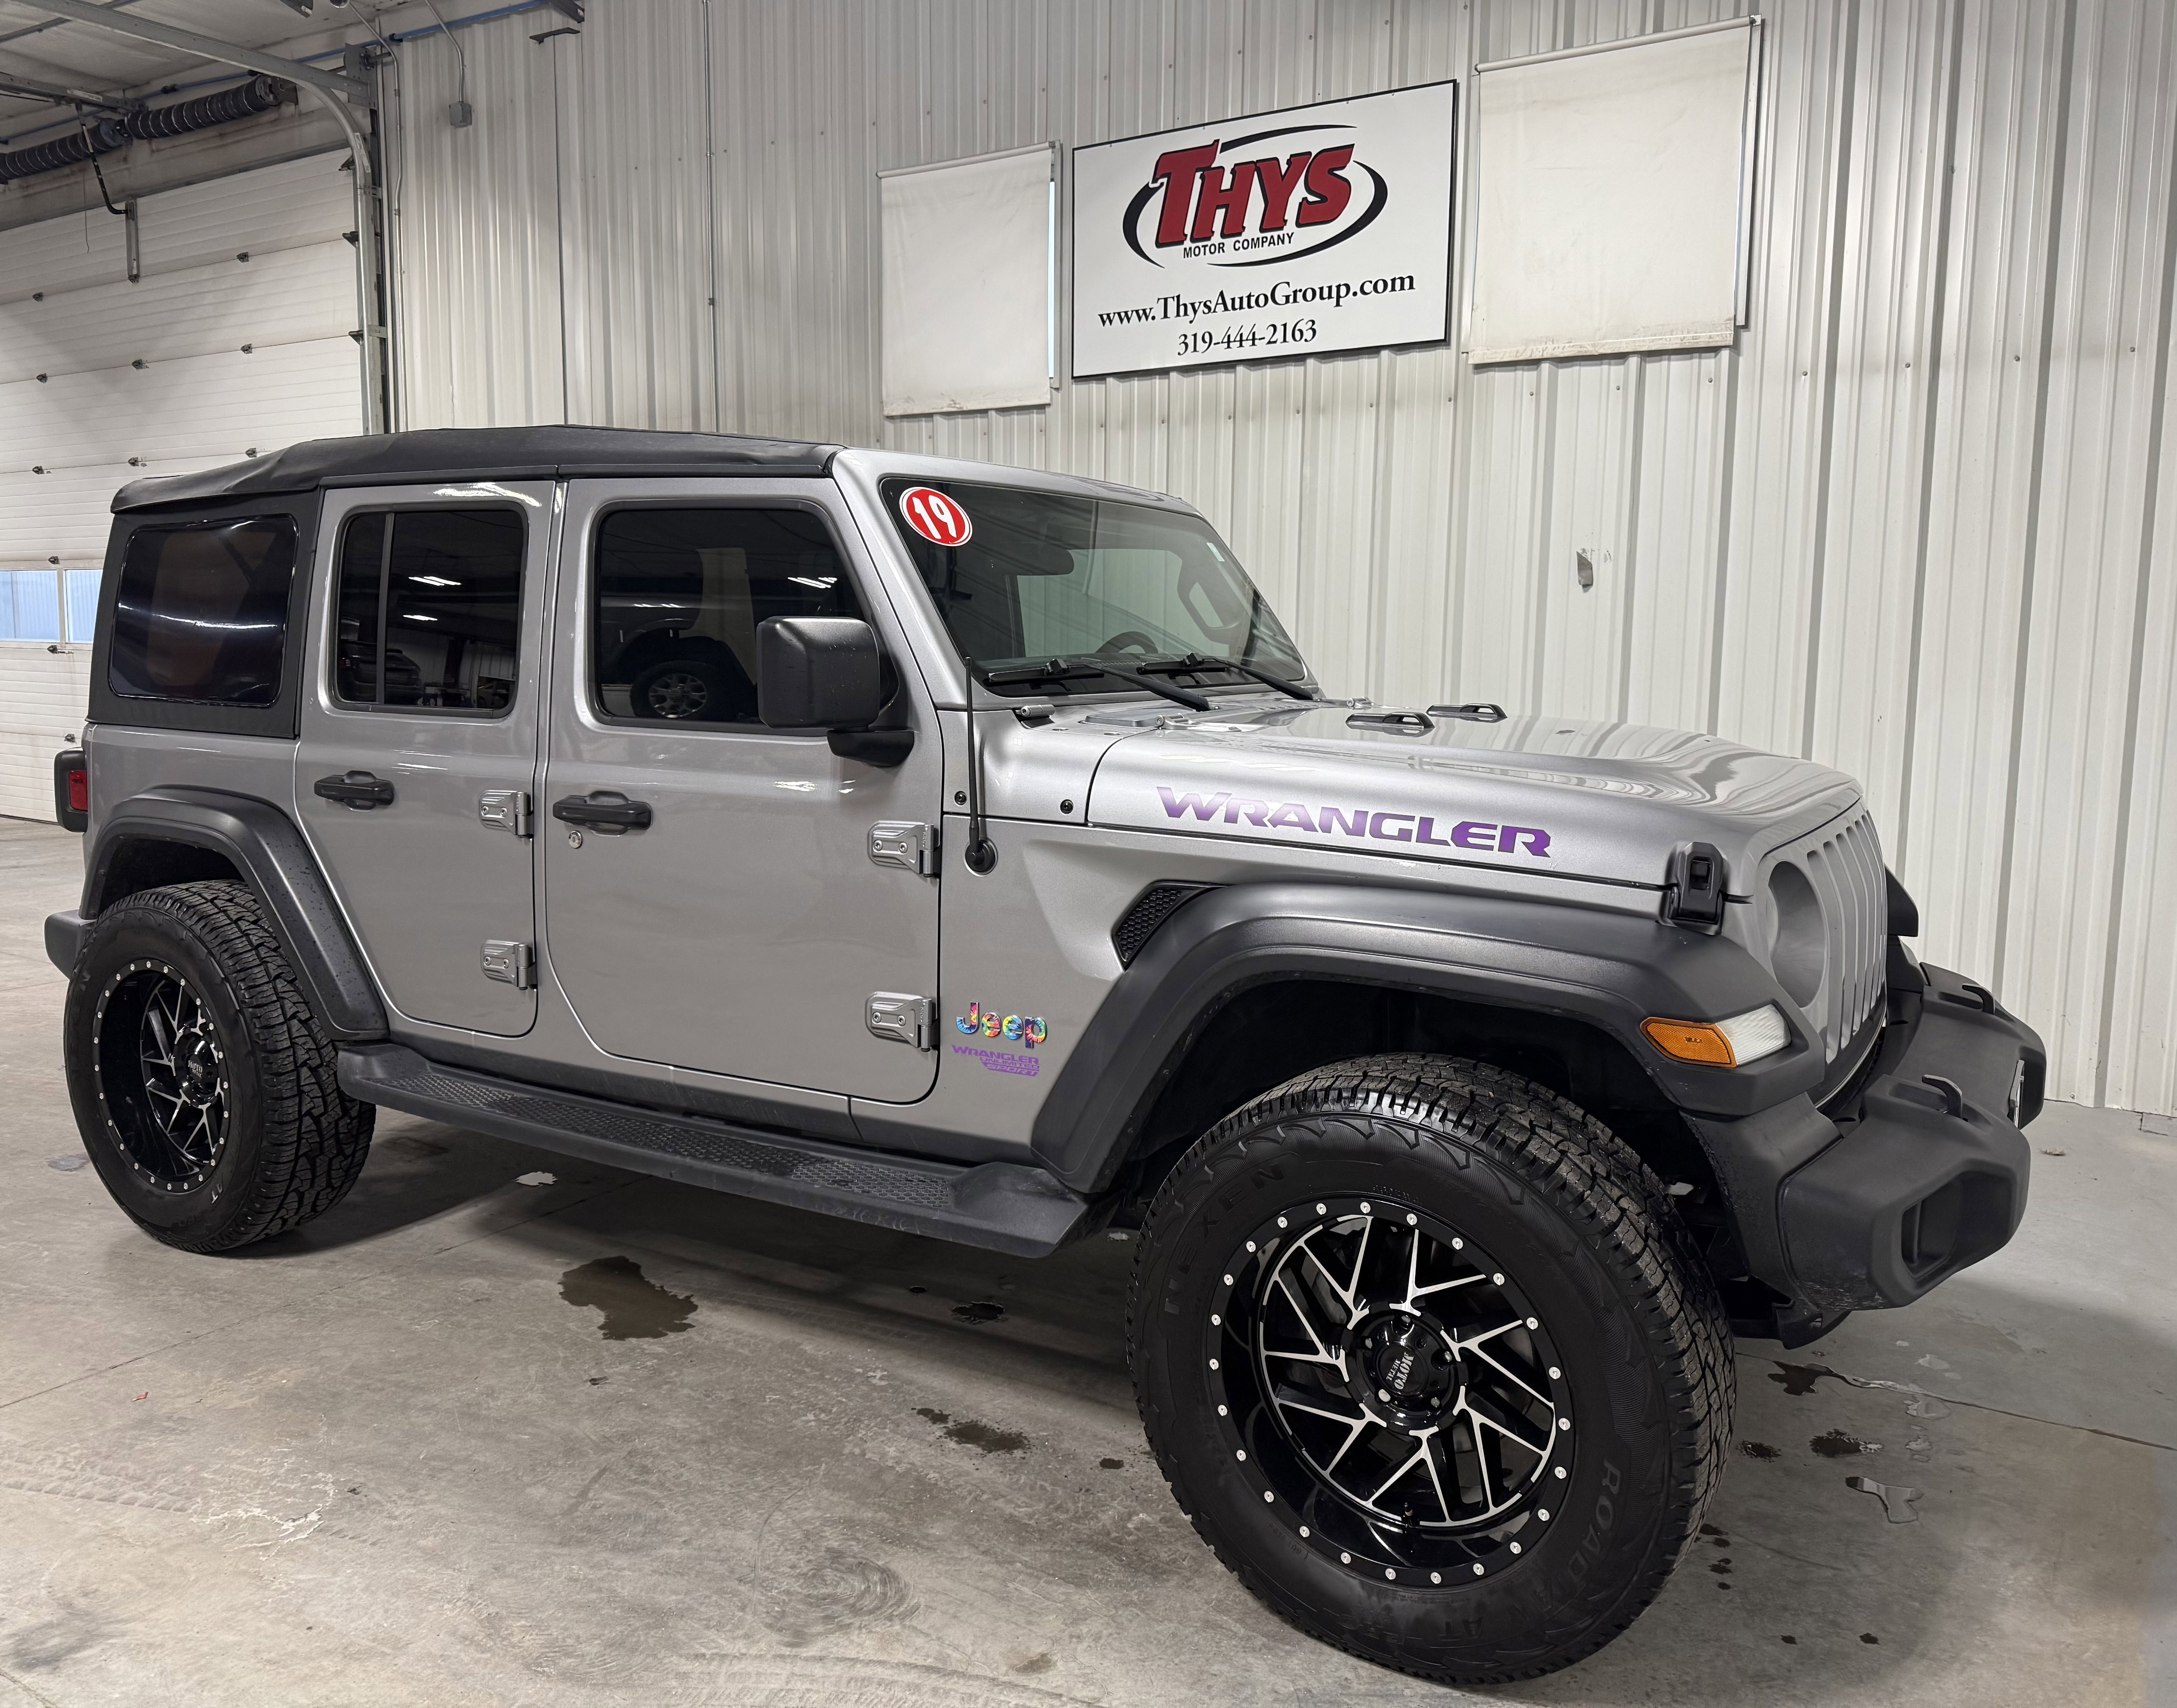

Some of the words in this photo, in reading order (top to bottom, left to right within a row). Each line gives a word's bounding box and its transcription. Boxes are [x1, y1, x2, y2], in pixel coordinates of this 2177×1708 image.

[1151, 139, 1355, 248] THYS
[1183, 242, 1225, 259] MOTOR
[1233, 232, 1294, 252] COMPANY
[1098, 274, 1416, 327] www.ThysAutoGroup.com
[1177, 319, 1317, 356] 319-444-2163
[912, 495, 957, 539] 19
[1156, 786, 1551, 858] WRANGLER
[956, 1001, 1048, 1048] Jeep
[951, 1044, 1039, 1064] WRANGLER
[980, 1057, 1040, 1069] UNLIMITED
[986, 1063, 1039, 1076] SPORT
[1164, 1164, 1284, 1315] NEXEN
[1386, 1358, 1401, 1381] METAL
[1394, 1351, 1414, 1390] MOTO
